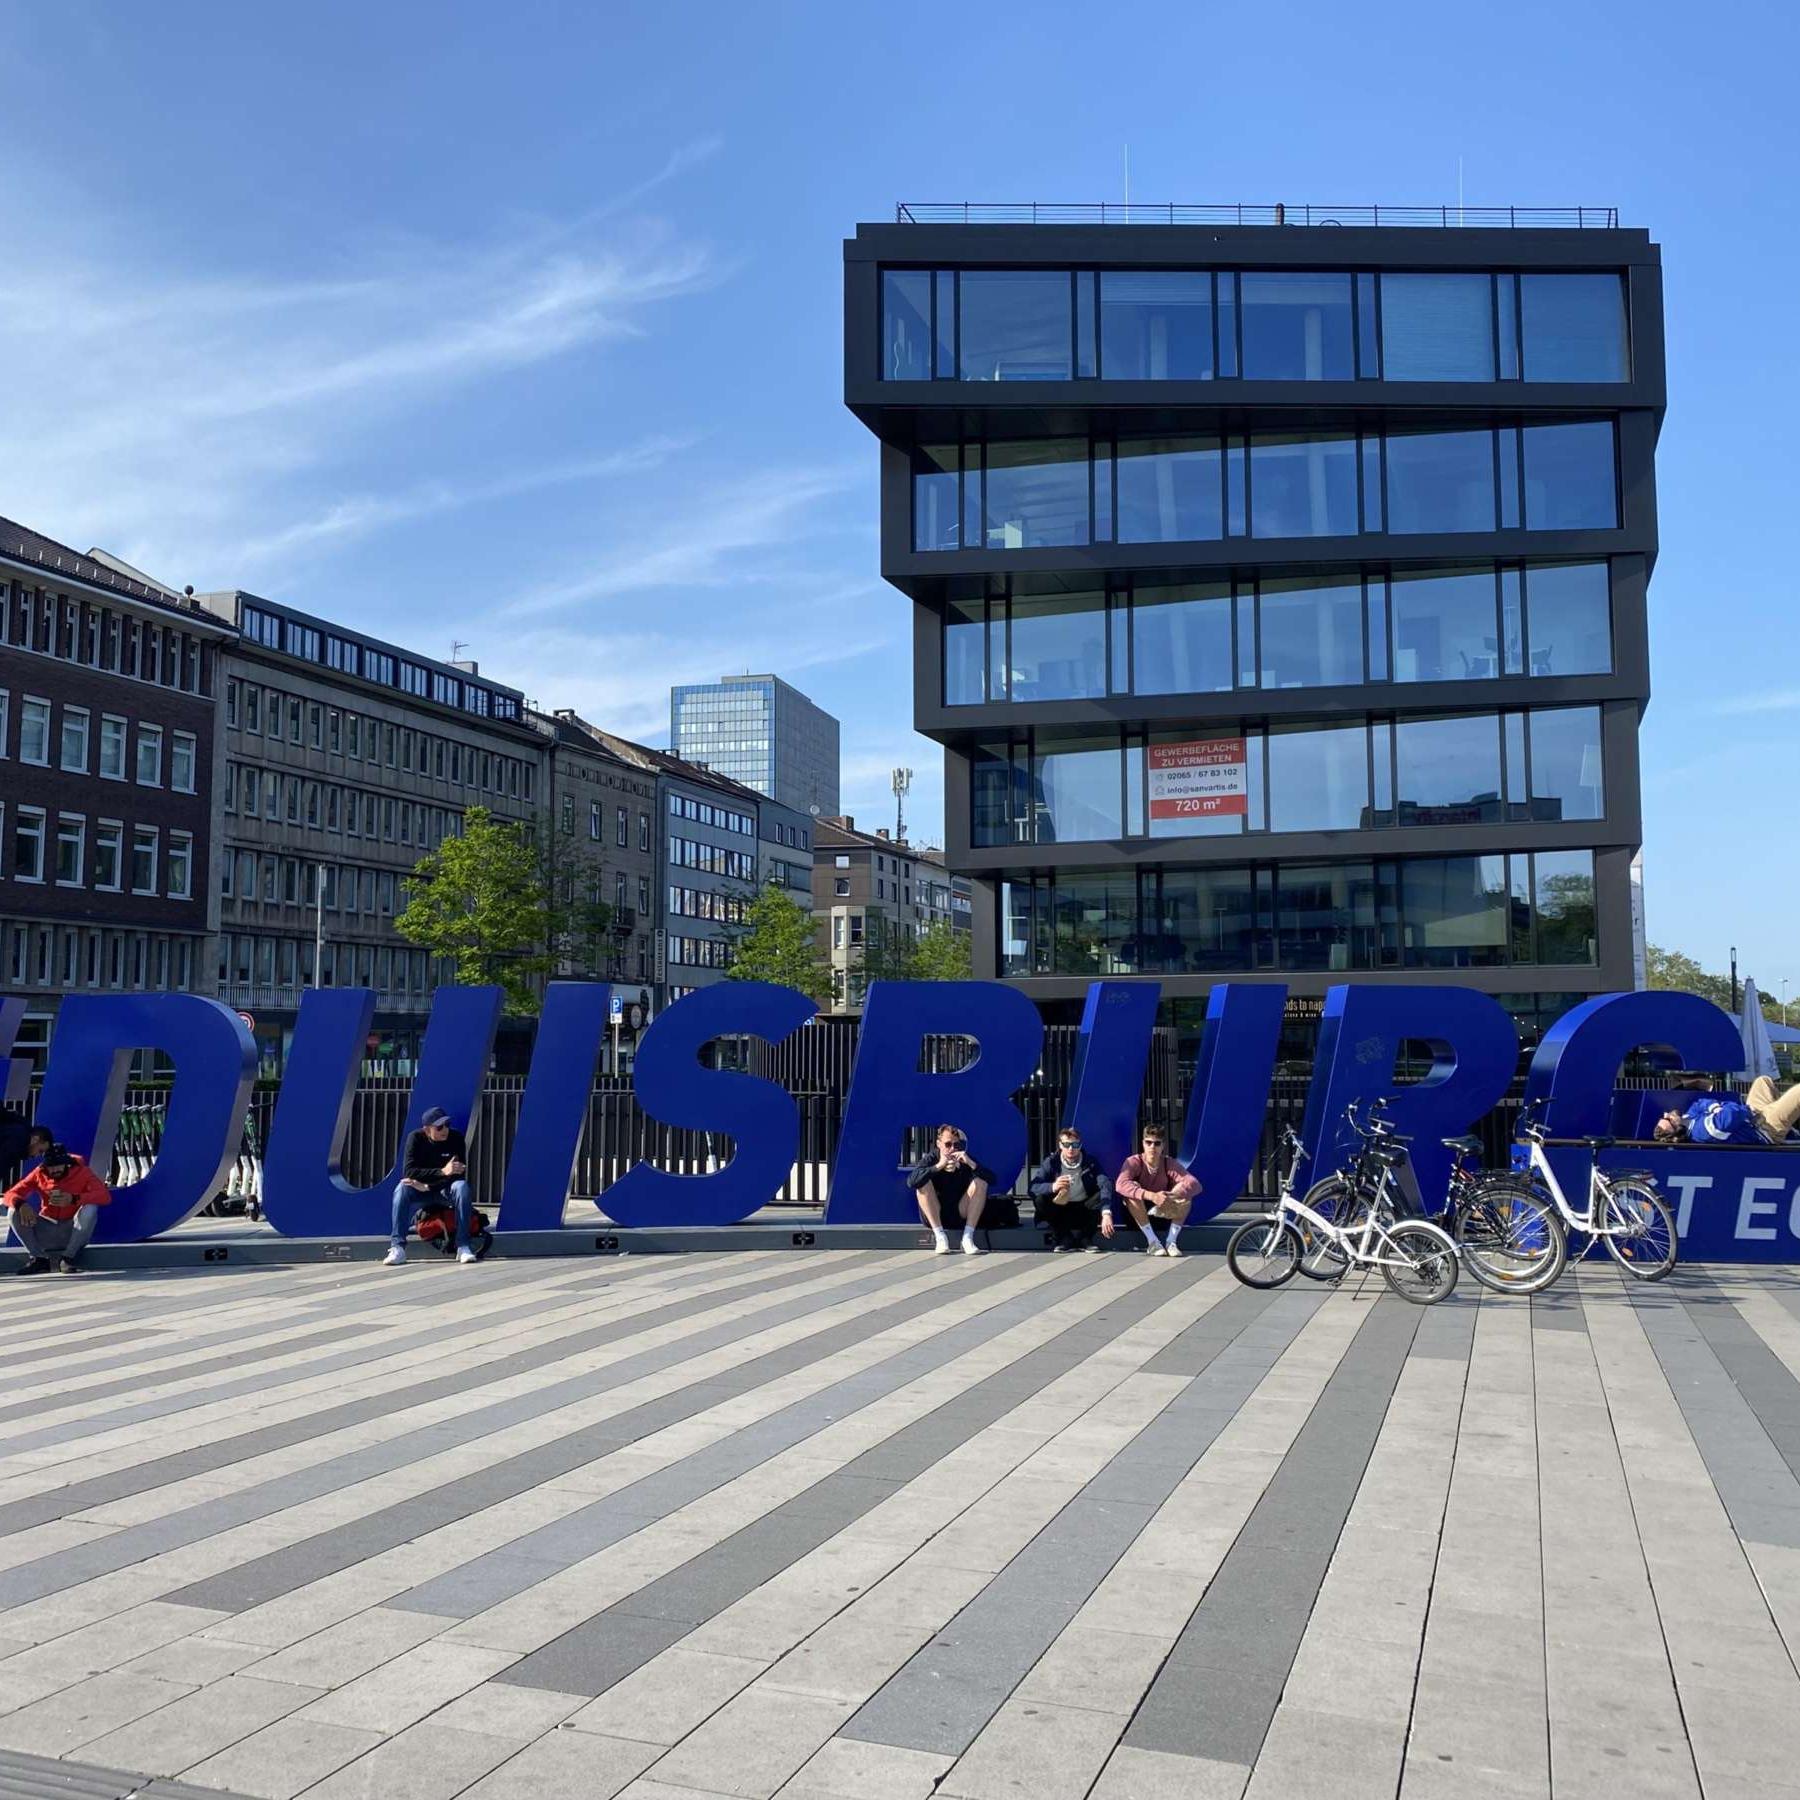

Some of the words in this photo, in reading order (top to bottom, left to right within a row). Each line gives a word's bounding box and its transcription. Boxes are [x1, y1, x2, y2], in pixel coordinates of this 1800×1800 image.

[1162, 758, 1175, 767] ZU
[1177, 754, 1232, 767] VERMIETEN
[1175, 799, 1200, 812] 720
[0, 979, 1746, 1246] DUISBURG
